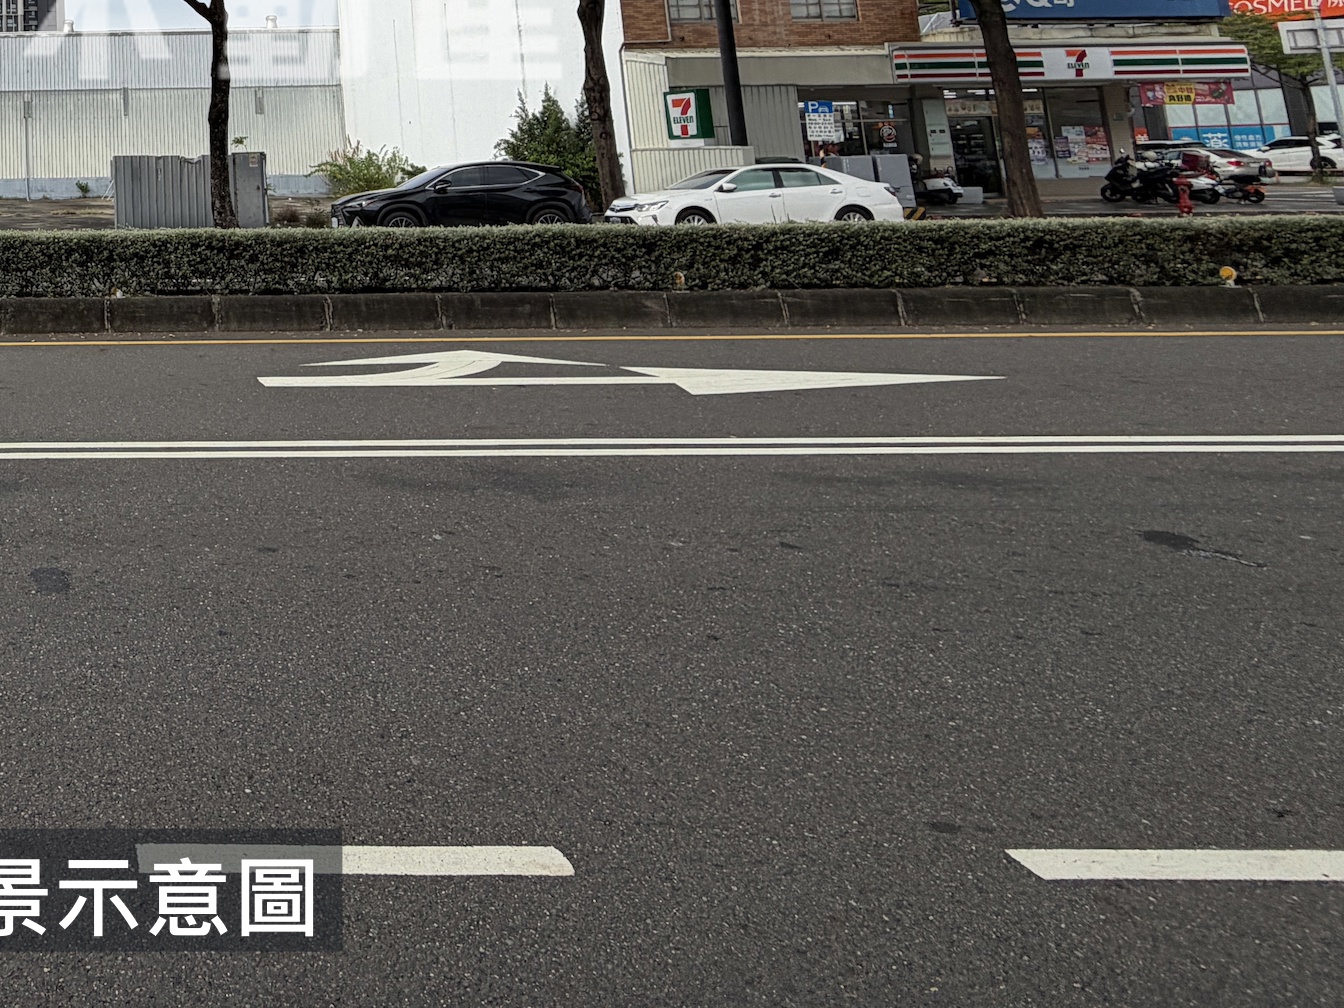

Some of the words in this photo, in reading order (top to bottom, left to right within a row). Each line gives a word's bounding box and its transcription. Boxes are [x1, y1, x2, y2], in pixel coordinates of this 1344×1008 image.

[1065, 49, 1087, 77] 7
[671, 97, 691, 136] 7
[807, 101, 819, 113] P
